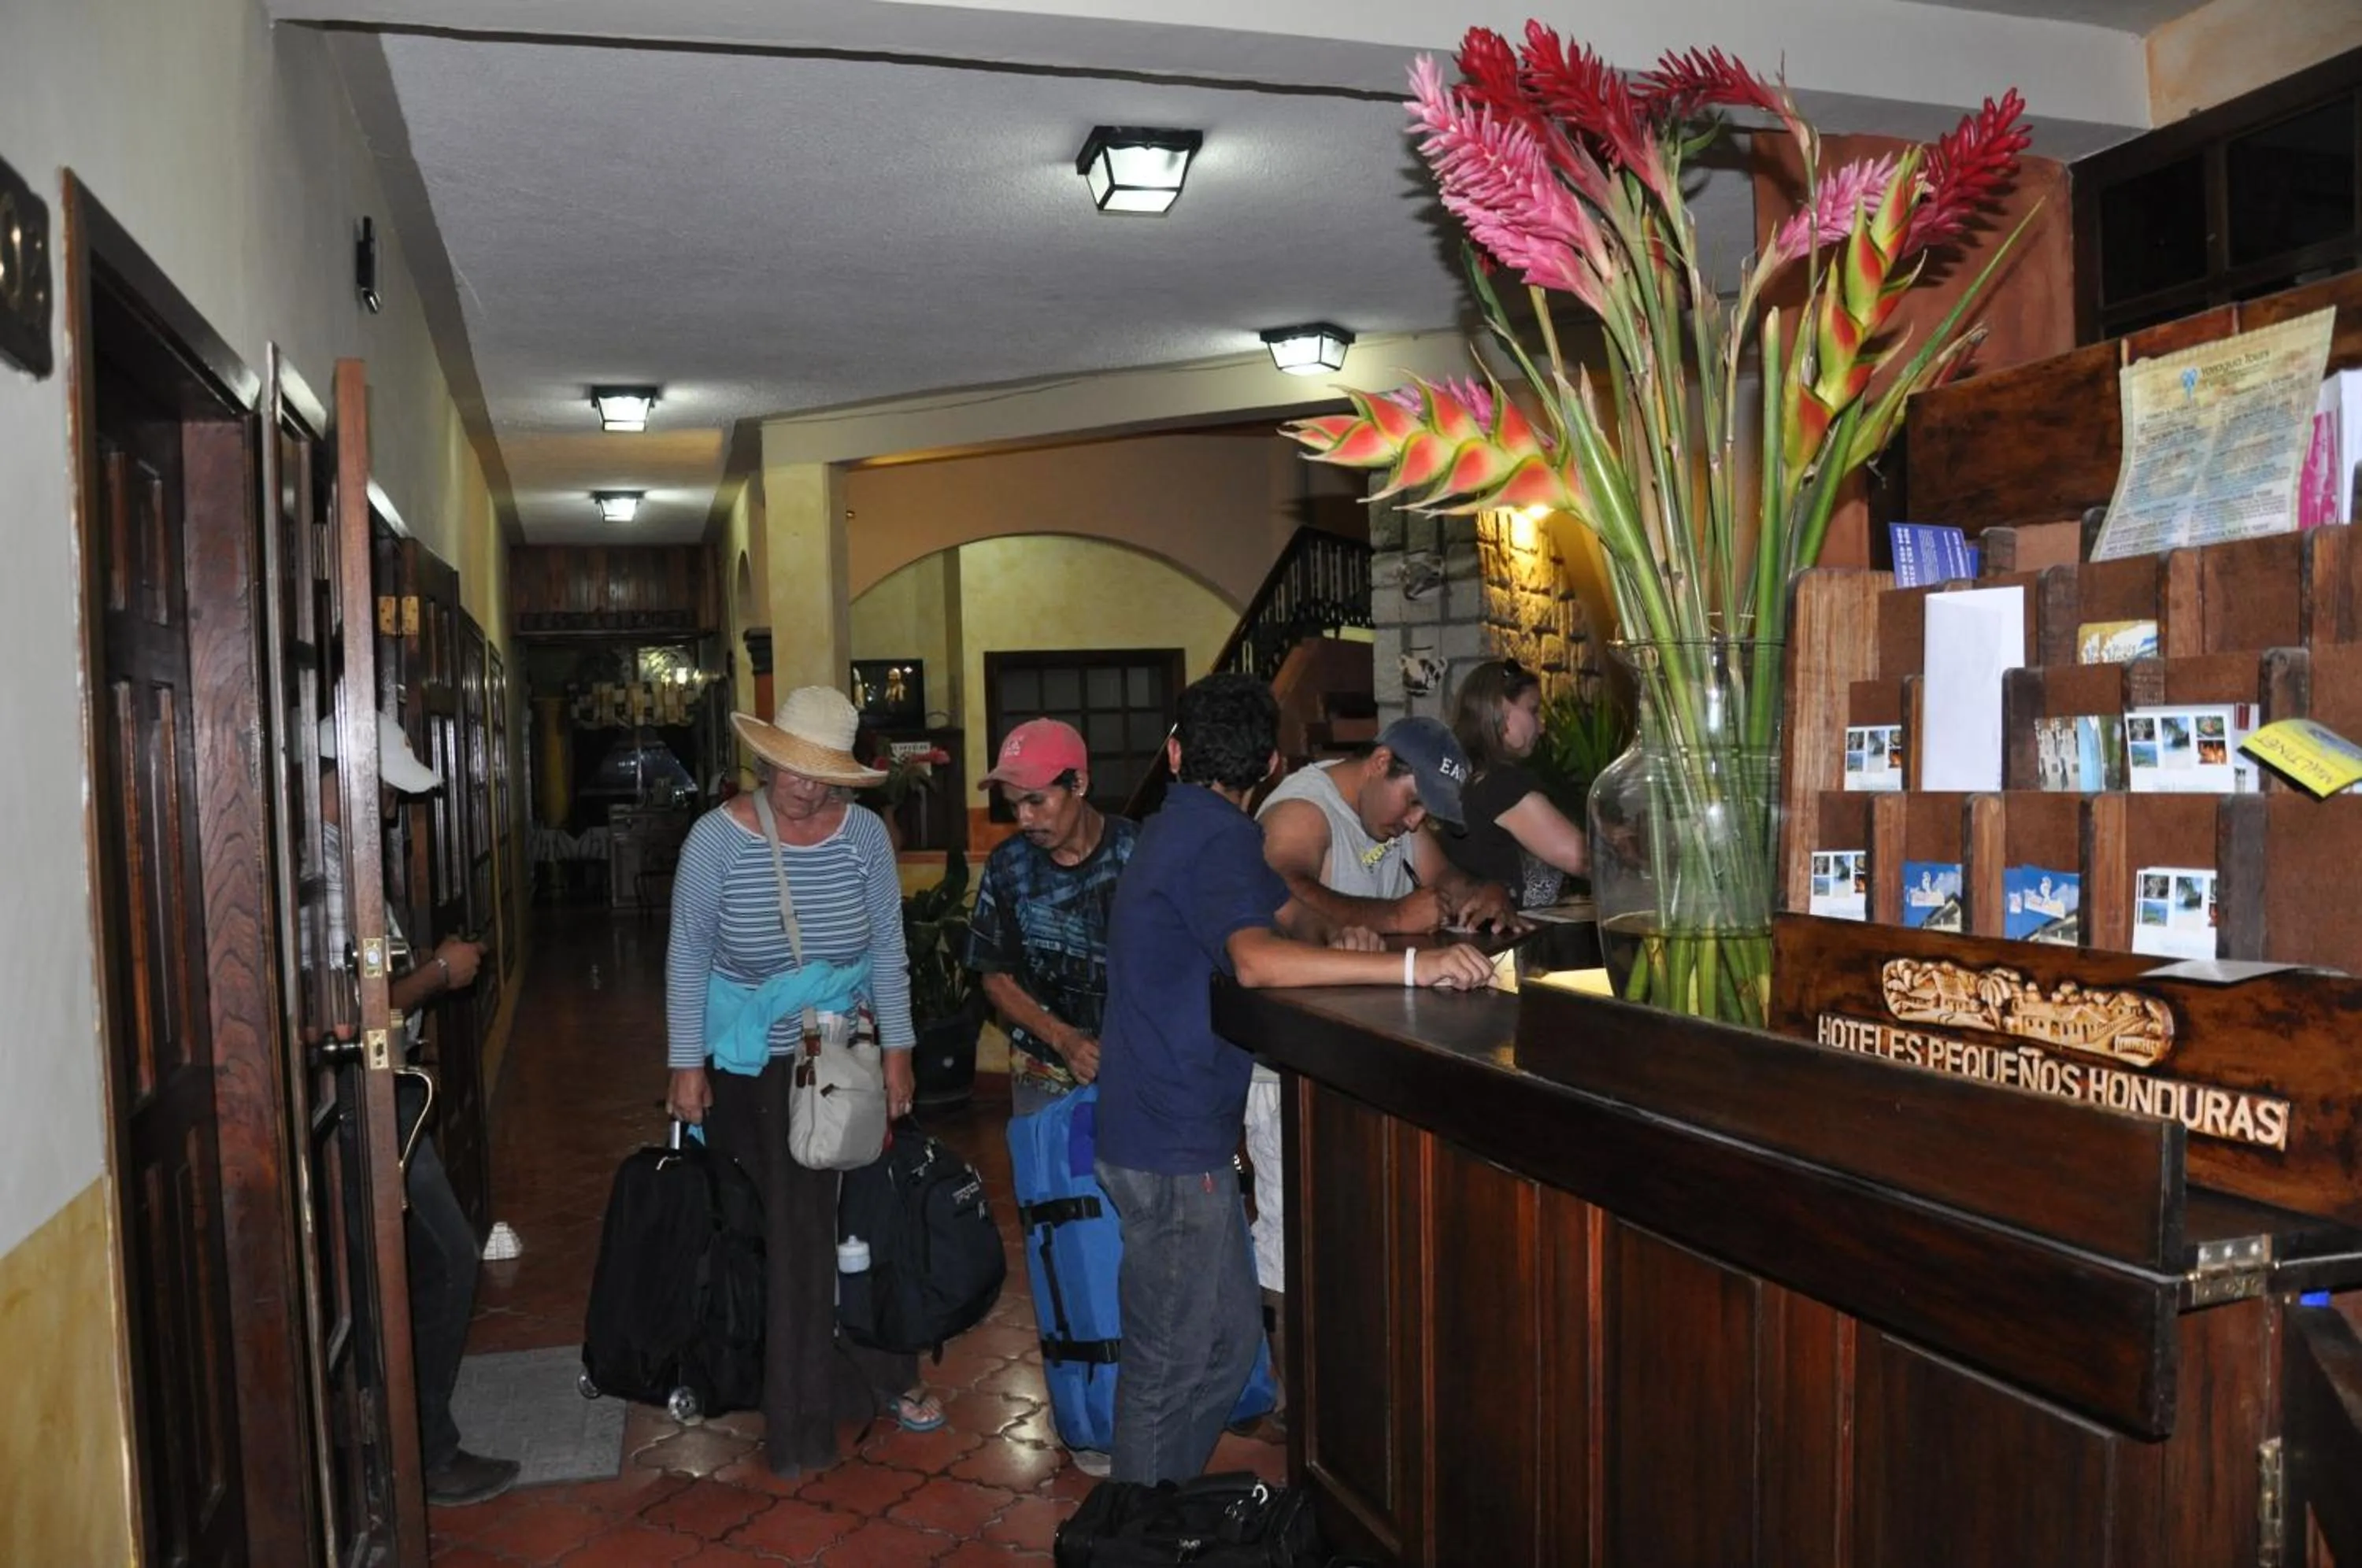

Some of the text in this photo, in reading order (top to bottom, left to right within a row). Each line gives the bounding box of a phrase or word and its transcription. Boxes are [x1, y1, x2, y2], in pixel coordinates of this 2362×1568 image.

[1817, 1012, 2283, 1145] HOTELES PEQUEÑOS HONDURAS
